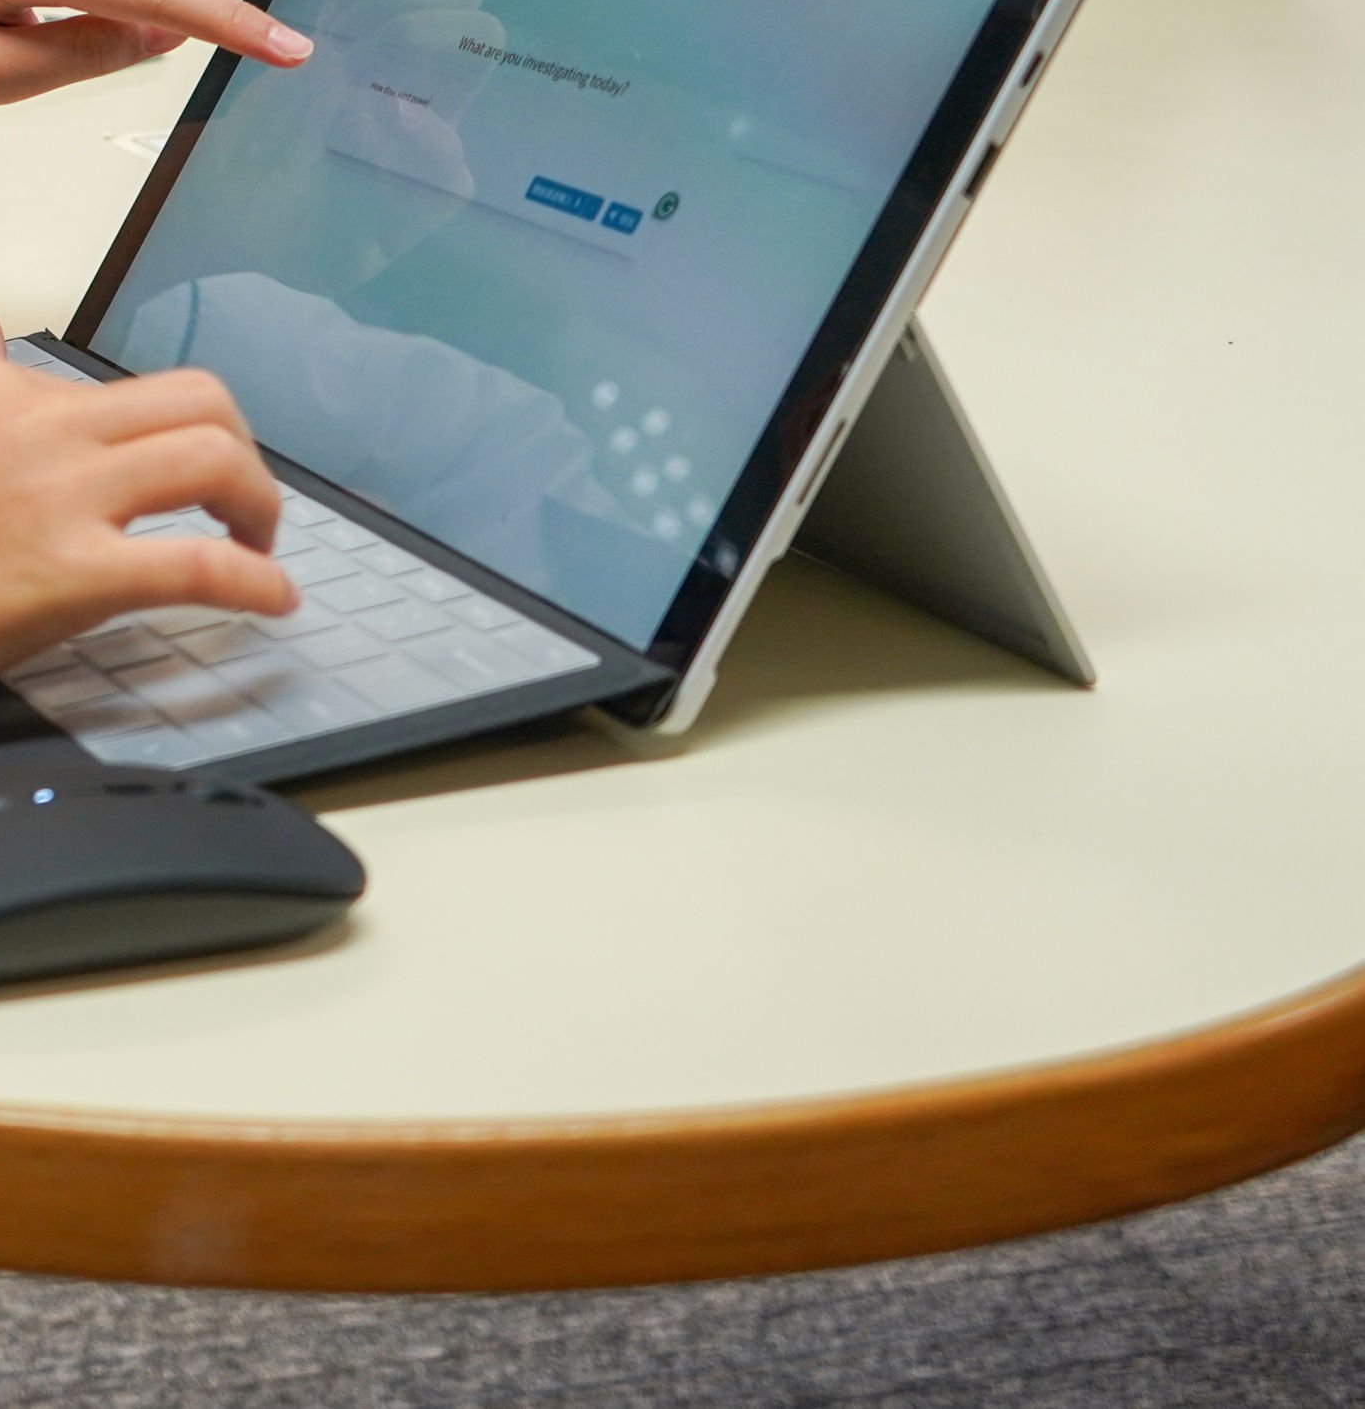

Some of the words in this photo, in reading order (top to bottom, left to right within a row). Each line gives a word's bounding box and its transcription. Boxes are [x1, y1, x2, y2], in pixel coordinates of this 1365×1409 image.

[458, 36, 486, 56] What
[484, 45, 502, 60] are
[500, 50, 521, 66] you
[522, 53, 589, 88] investigating
[590, 75, 630, 97] today?
